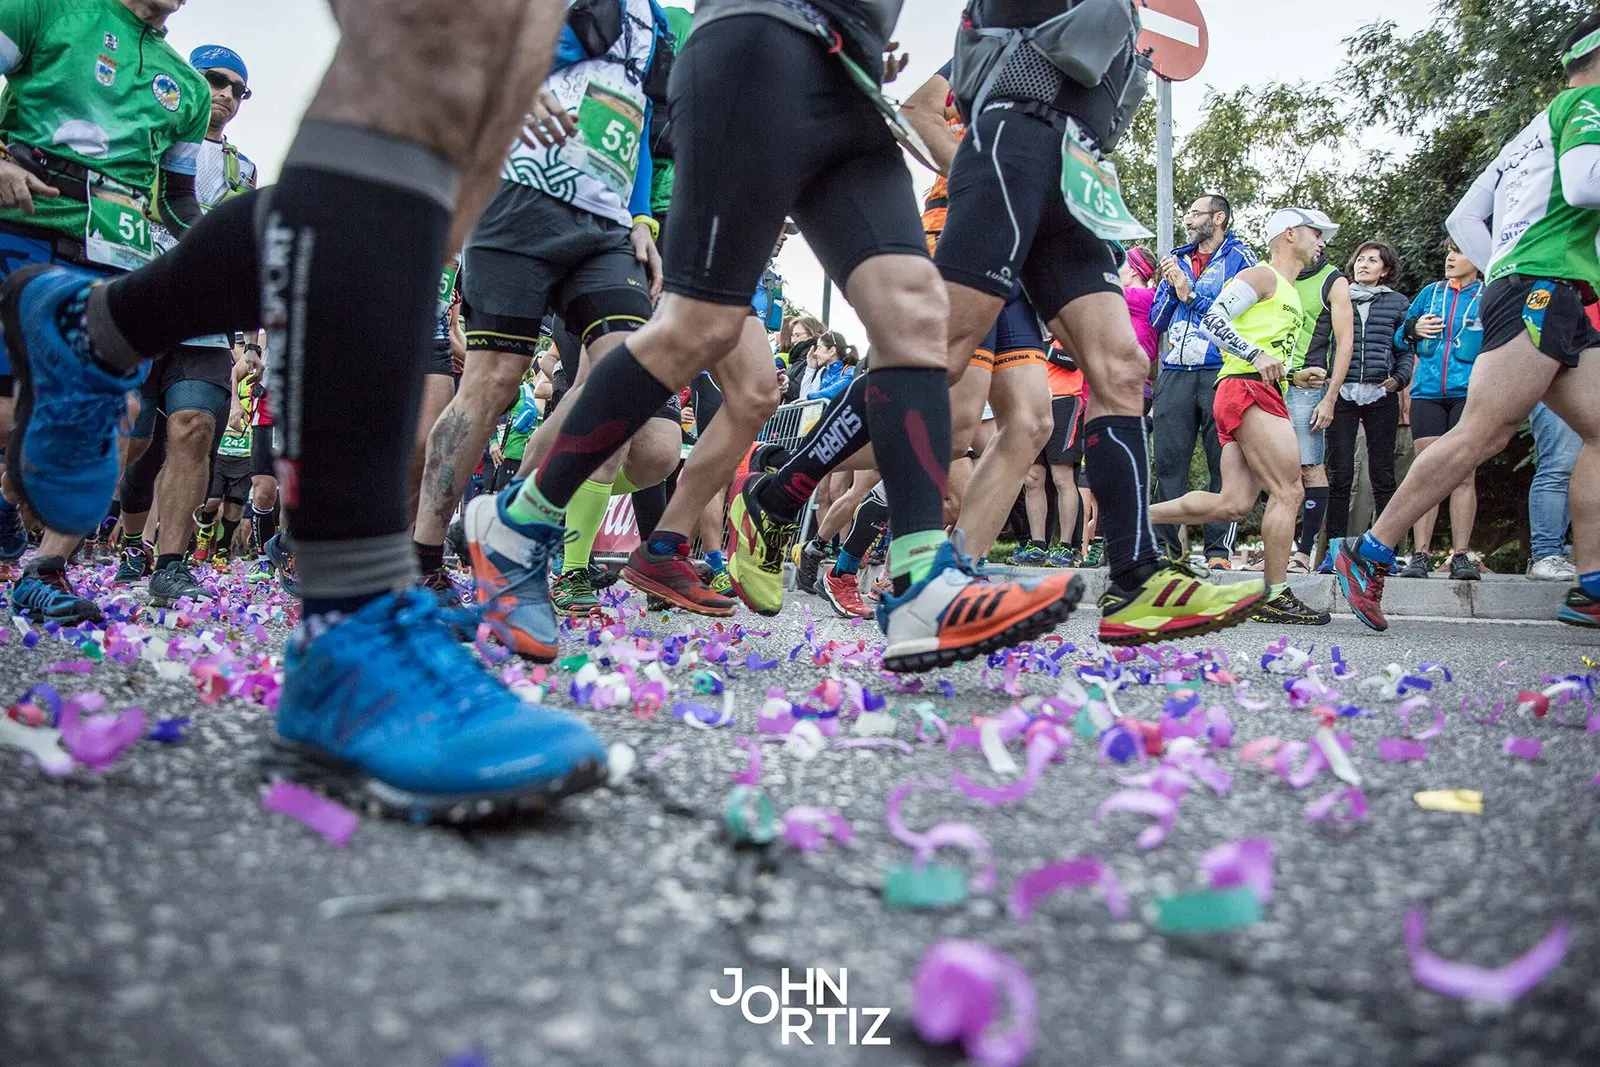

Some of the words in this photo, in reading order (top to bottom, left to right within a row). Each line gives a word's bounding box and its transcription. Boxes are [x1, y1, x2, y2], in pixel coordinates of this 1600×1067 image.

[1079, 170, 1120, 219] 735
[119, 211, 151, 246] 51
[993, 354, 1031, 367] ARCHENA
[224, 437, 246, 447] 242
[807, 404, 863, 465] SURAL
